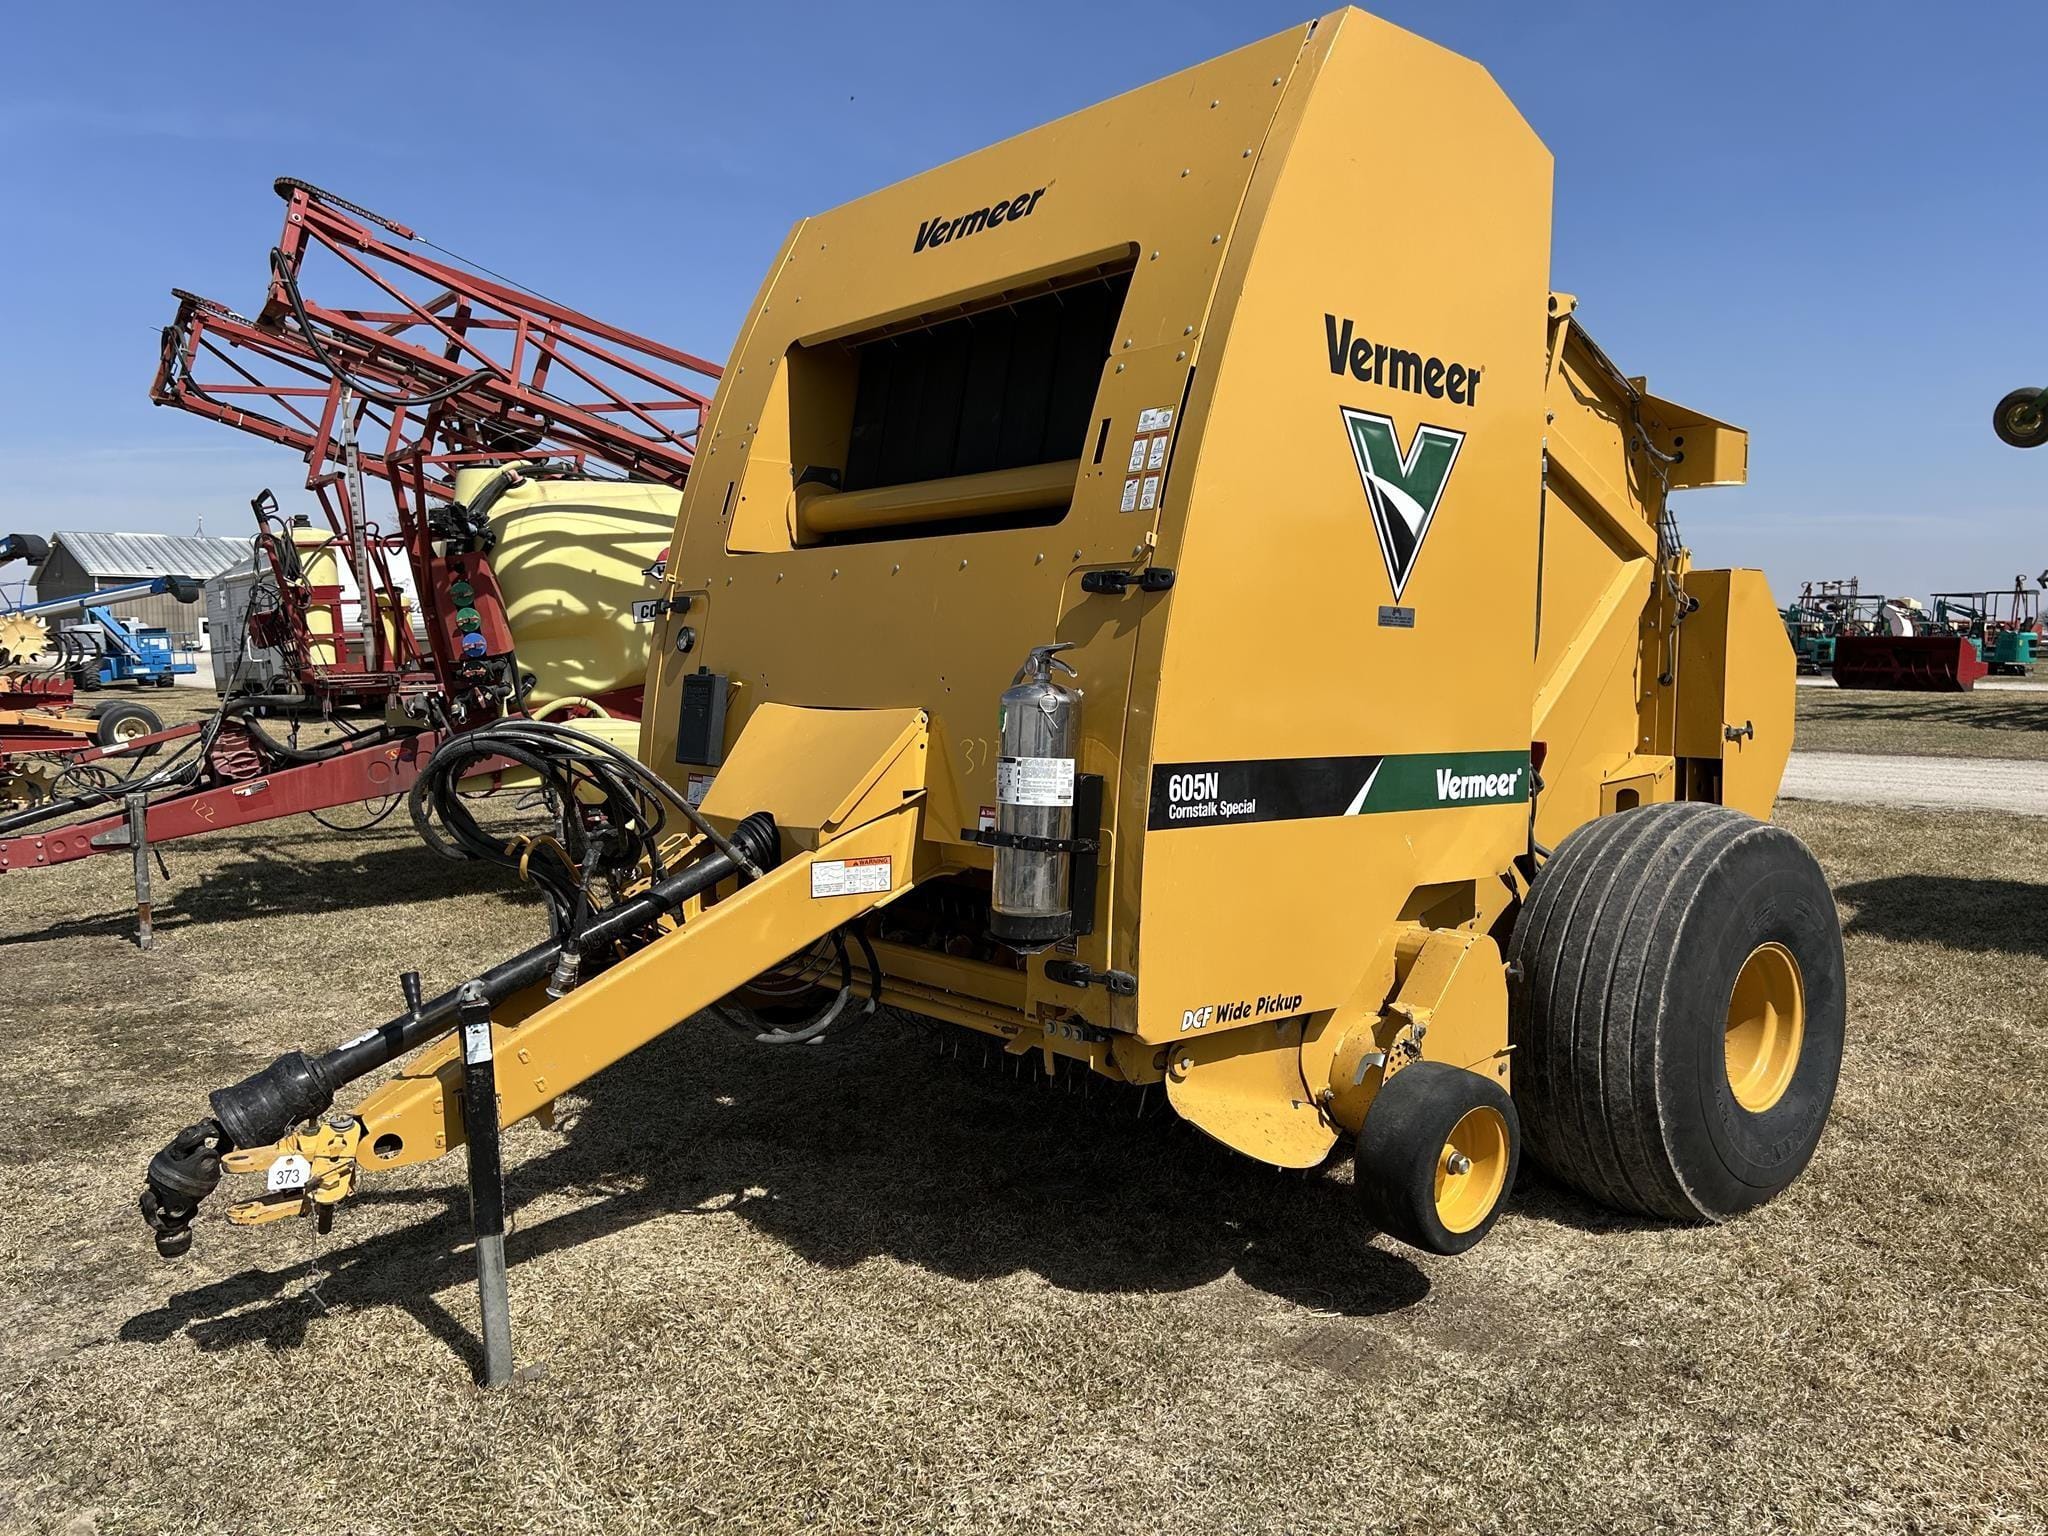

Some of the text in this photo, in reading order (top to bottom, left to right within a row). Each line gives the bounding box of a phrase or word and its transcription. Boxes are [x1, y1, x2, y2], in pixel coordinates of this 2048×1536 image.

[913, 182, 1046, 254] Vermeer
[1325, 313, 1480, 407] Vermeer
[1169, 772, 1219, 802] 605N
[1436, 768, 1518, 800] Vermeer
[1169, 799, 1256, 819] Cornstalk Special
[1180, 994, 1303, 1032] DCF Wide Pickup
[276, 1169, 300, 1185] 373
